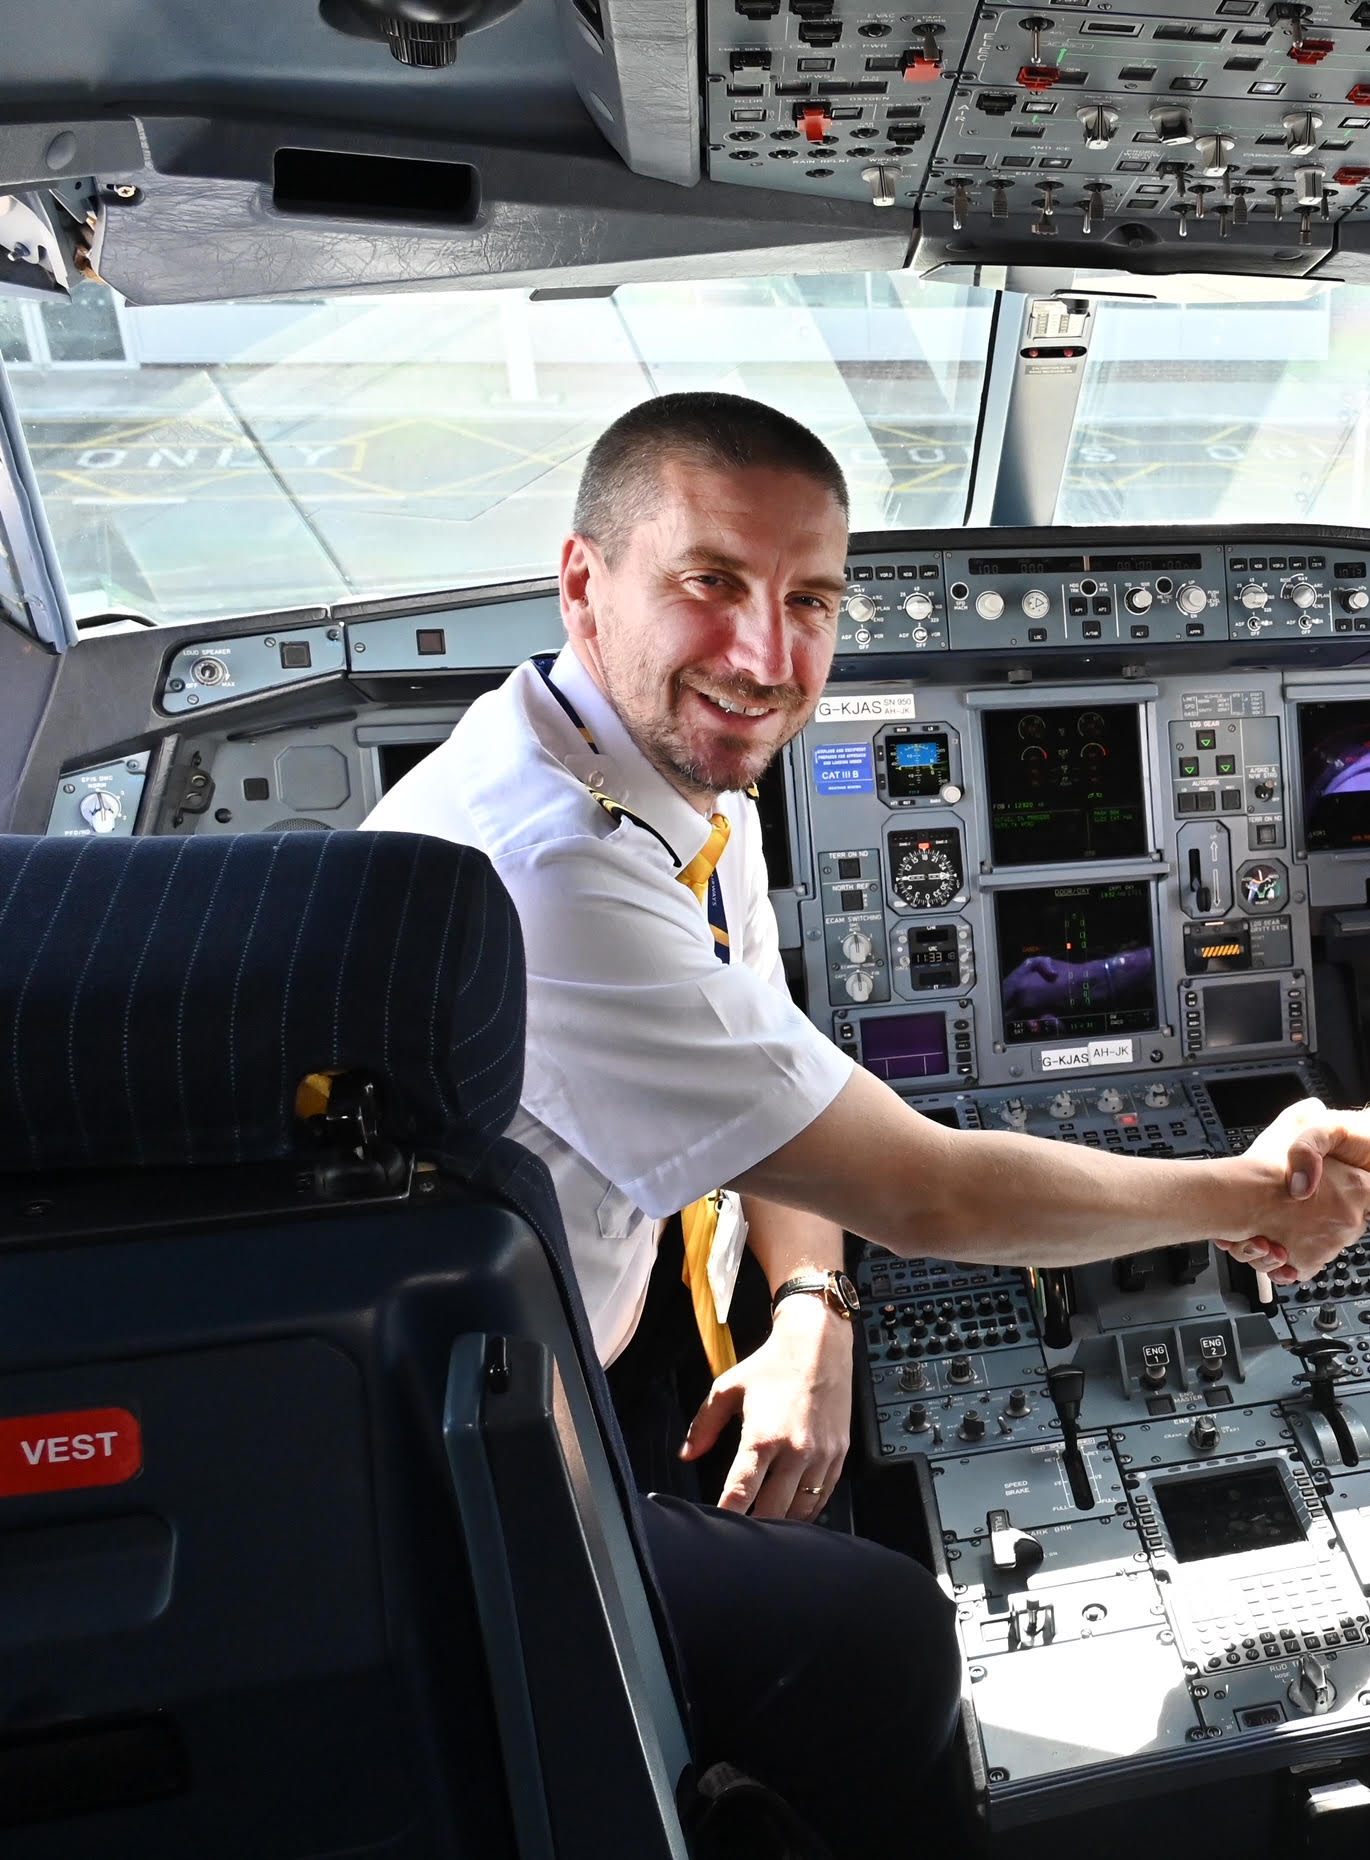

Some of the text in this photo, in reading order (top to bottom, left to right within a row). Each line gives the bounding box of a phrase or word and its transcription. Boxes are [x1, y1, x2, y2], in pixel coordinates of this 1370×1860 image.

[977, 32, 995, 62] ELEC
[78, 446, 338, 469] ONLY
[819, 701, 882, 716] G-KJAS
[822, 770, 859, 780] CAT III B
[848, 914, 882, 922] SWITCHING
[1093, 1046, 1128, 1057] AH-JK
[1042, 1053, 1088, 1067] G-KJAS
[1202, 1338, 1221, 1348] ENG
[1145, 1346, 1164, 1356] ENG
[1210, 1348, 1217, 1356] 2
[1174, 1396, 1202, 1404] MASTER
[20, 1431, 118, 1465] VEST
[1004, 1480, 1028, 1488] SPEED
[1005, 1487, 1030, 1496] BRAKE
[995, 1515, 1003, 1531] PULL
[1031, 1525, 1072, 1536] ARK BRK
[1269, 1664, 1287, 1673] RUD
